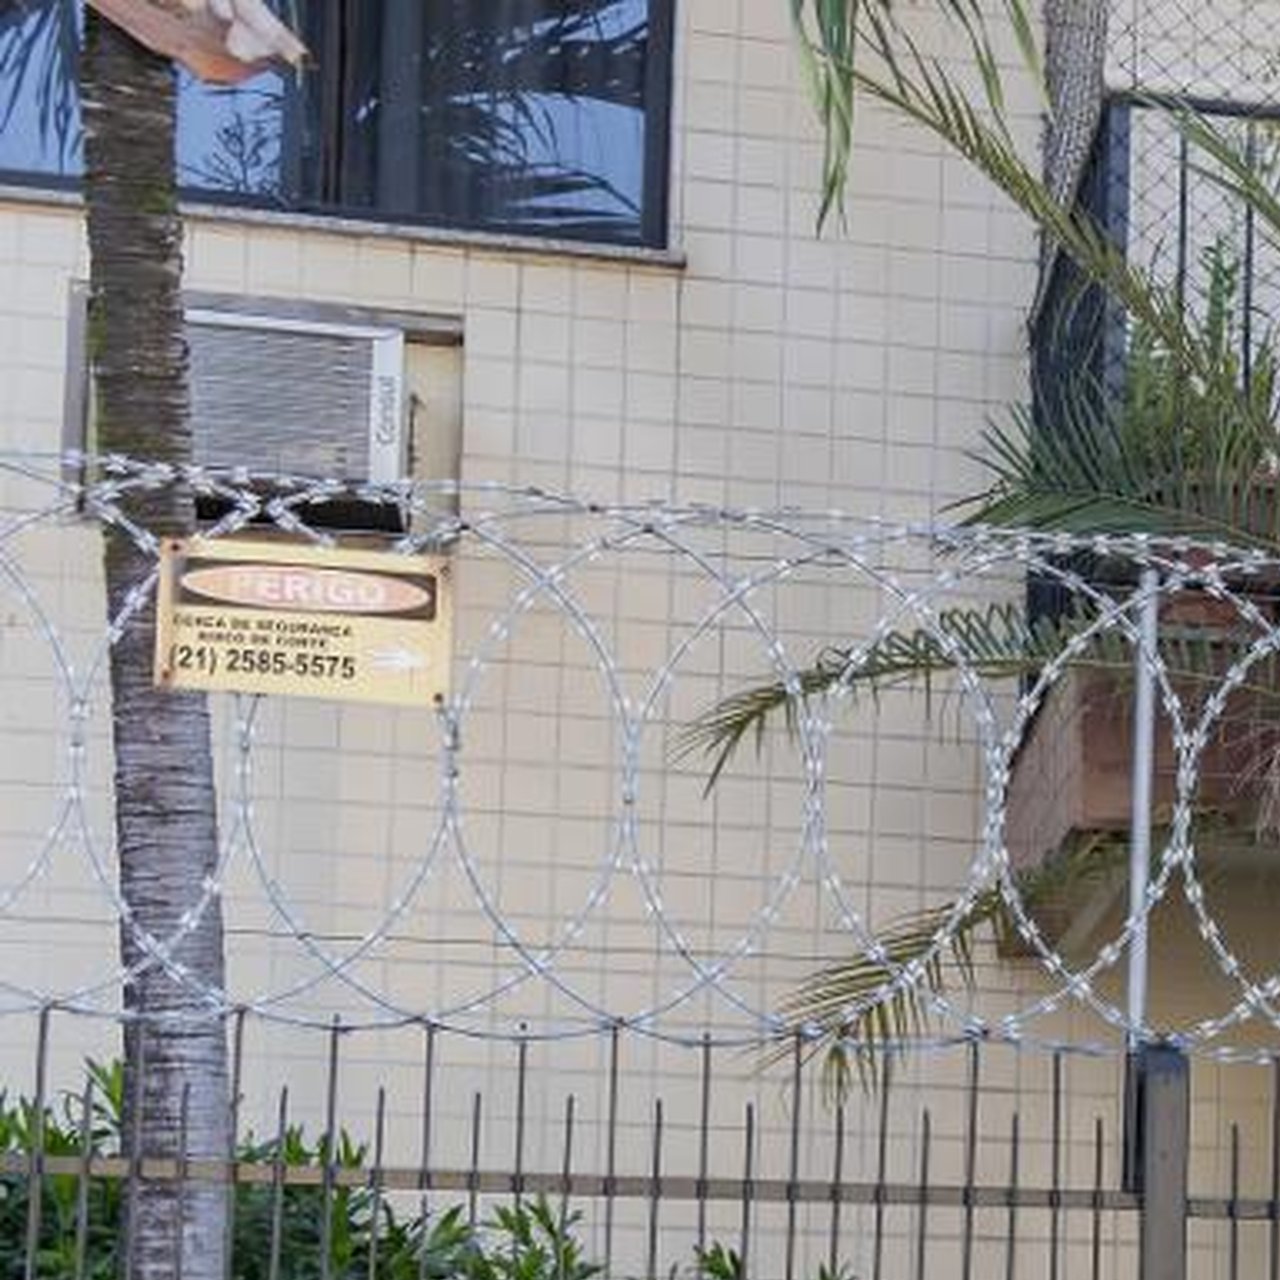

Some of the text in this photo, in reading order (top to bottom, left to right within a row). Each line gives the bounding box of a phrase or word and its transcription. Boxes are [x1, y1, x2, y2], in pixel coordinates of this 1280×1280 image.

[237, 573, 386, 604] PERIGO
[173, 613, 226, 628] CERCA
[231, 617, 251, 631] DE
[169, 643, 356, 680] (21) 2585-5575
